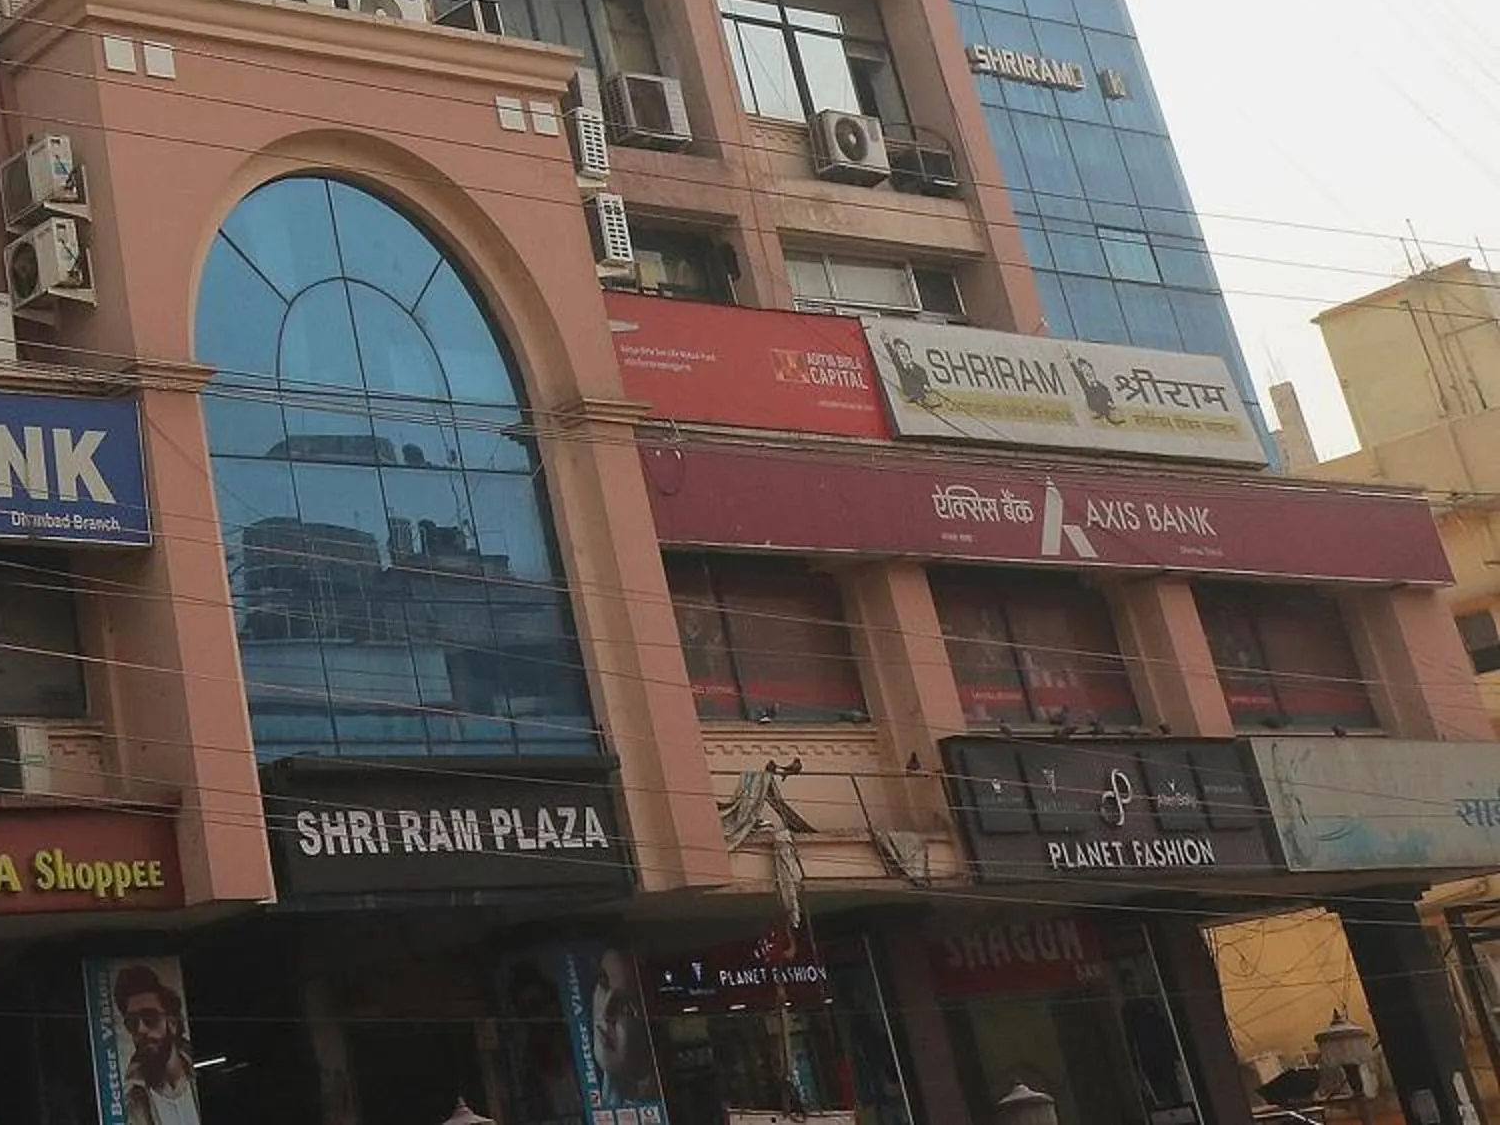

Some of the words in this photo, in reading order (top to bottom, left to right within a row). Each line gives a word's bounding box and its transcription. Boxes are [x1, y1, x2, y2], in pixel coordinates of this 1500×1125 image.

[809, 366, 869, 391] CAPITAL
[926, 348, 1068, 397] SHRIRAM
[1114, 368, 1229, 412] श्रीराम
[1001, 488, 1034, 523] बैंक
[1086, 499, 1141, 531] AXIS
[1145, 503, 1217, 536] BANK
[297, 809, 389, 856] SHRI
[400, 809, 484, 853] RAM
[490, 806, 610, 850] PLAZA
[1048, 840, 1122, 869] PLANET
[1132, 838, 1215, 868] FASHION
[34, 848, 165, 898] Shoppee
[718, 967, 767, 986] PLANET
